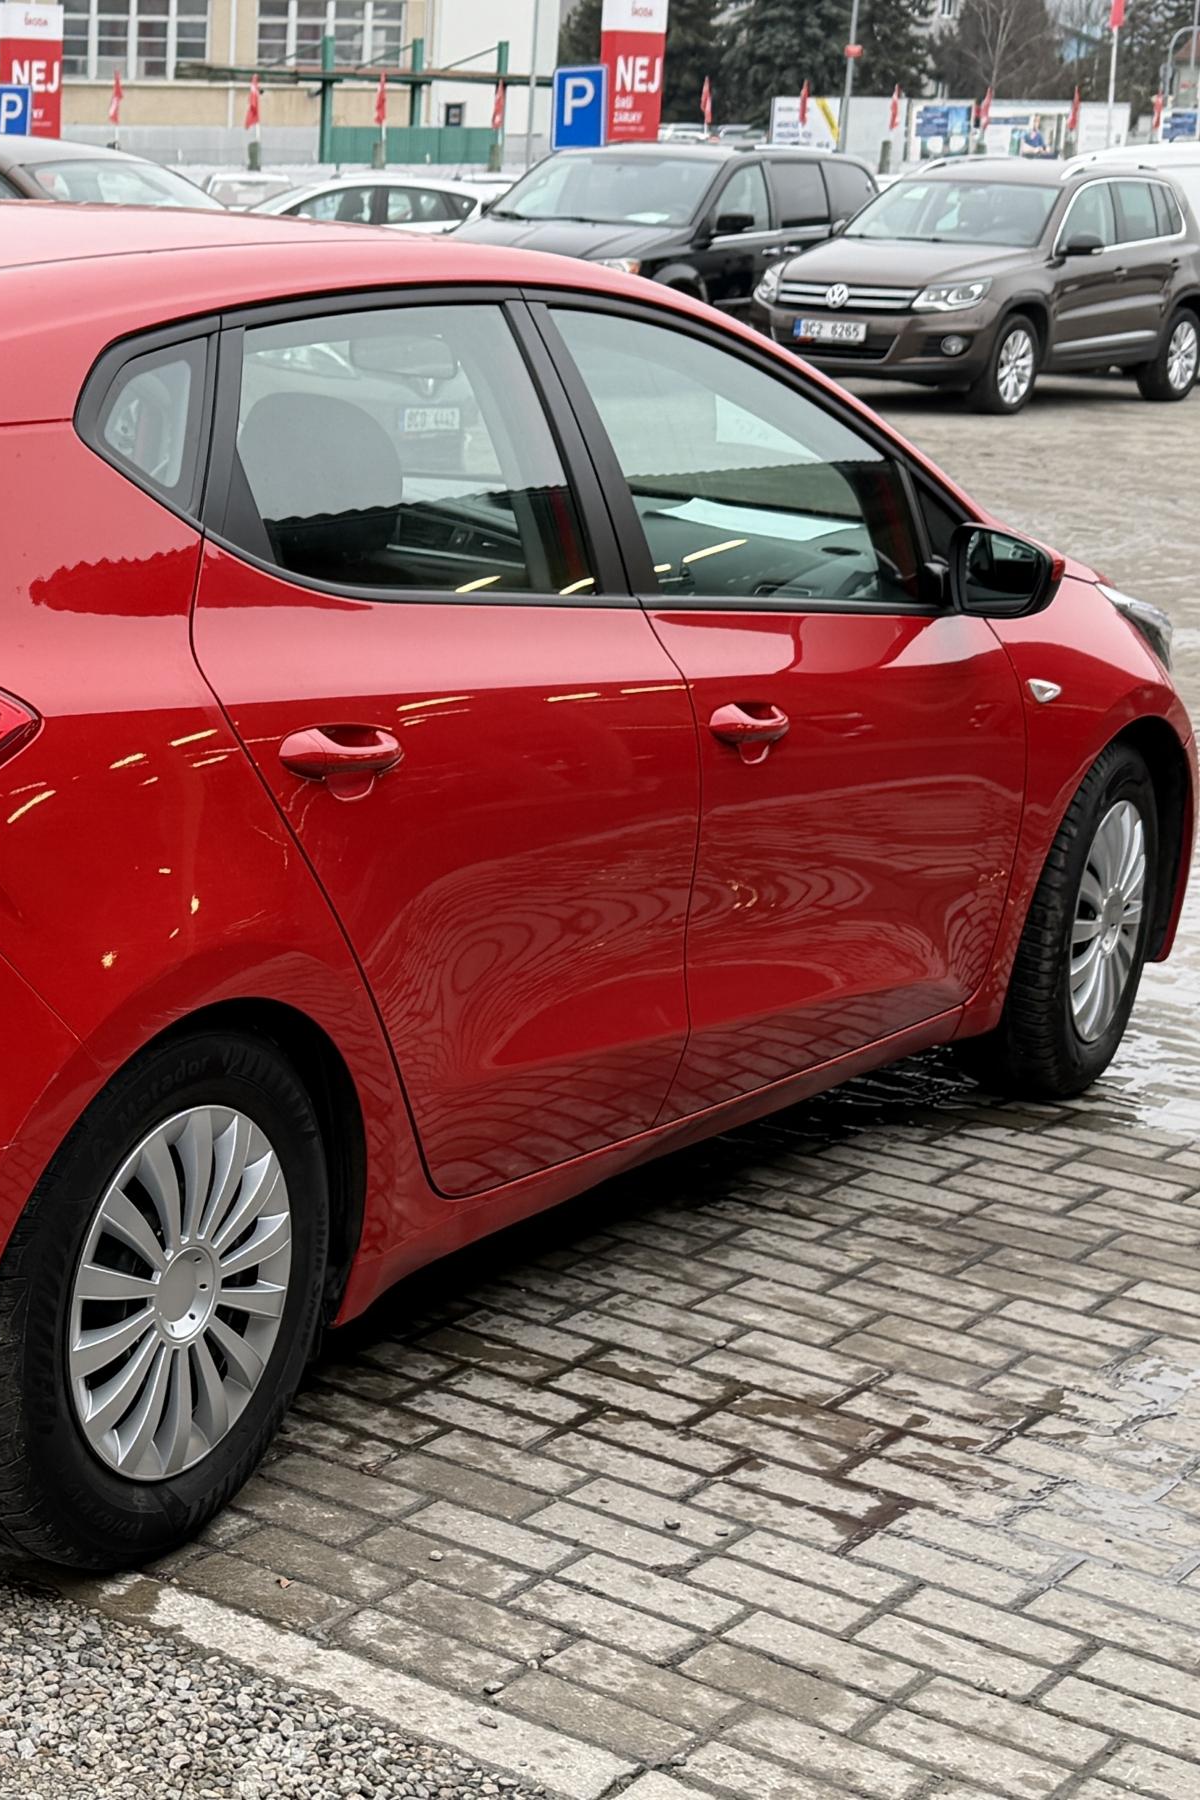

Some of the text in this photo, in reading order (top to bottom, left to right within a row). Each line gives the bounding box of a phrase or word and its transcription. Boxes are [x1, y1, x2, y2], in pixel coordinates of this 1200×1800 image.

[11, 59, 60, 93] NEJ
[615, 55, 662, 93] NEJ
[0, 92, 23, 133] P
[563, 77, 595, 126] P
